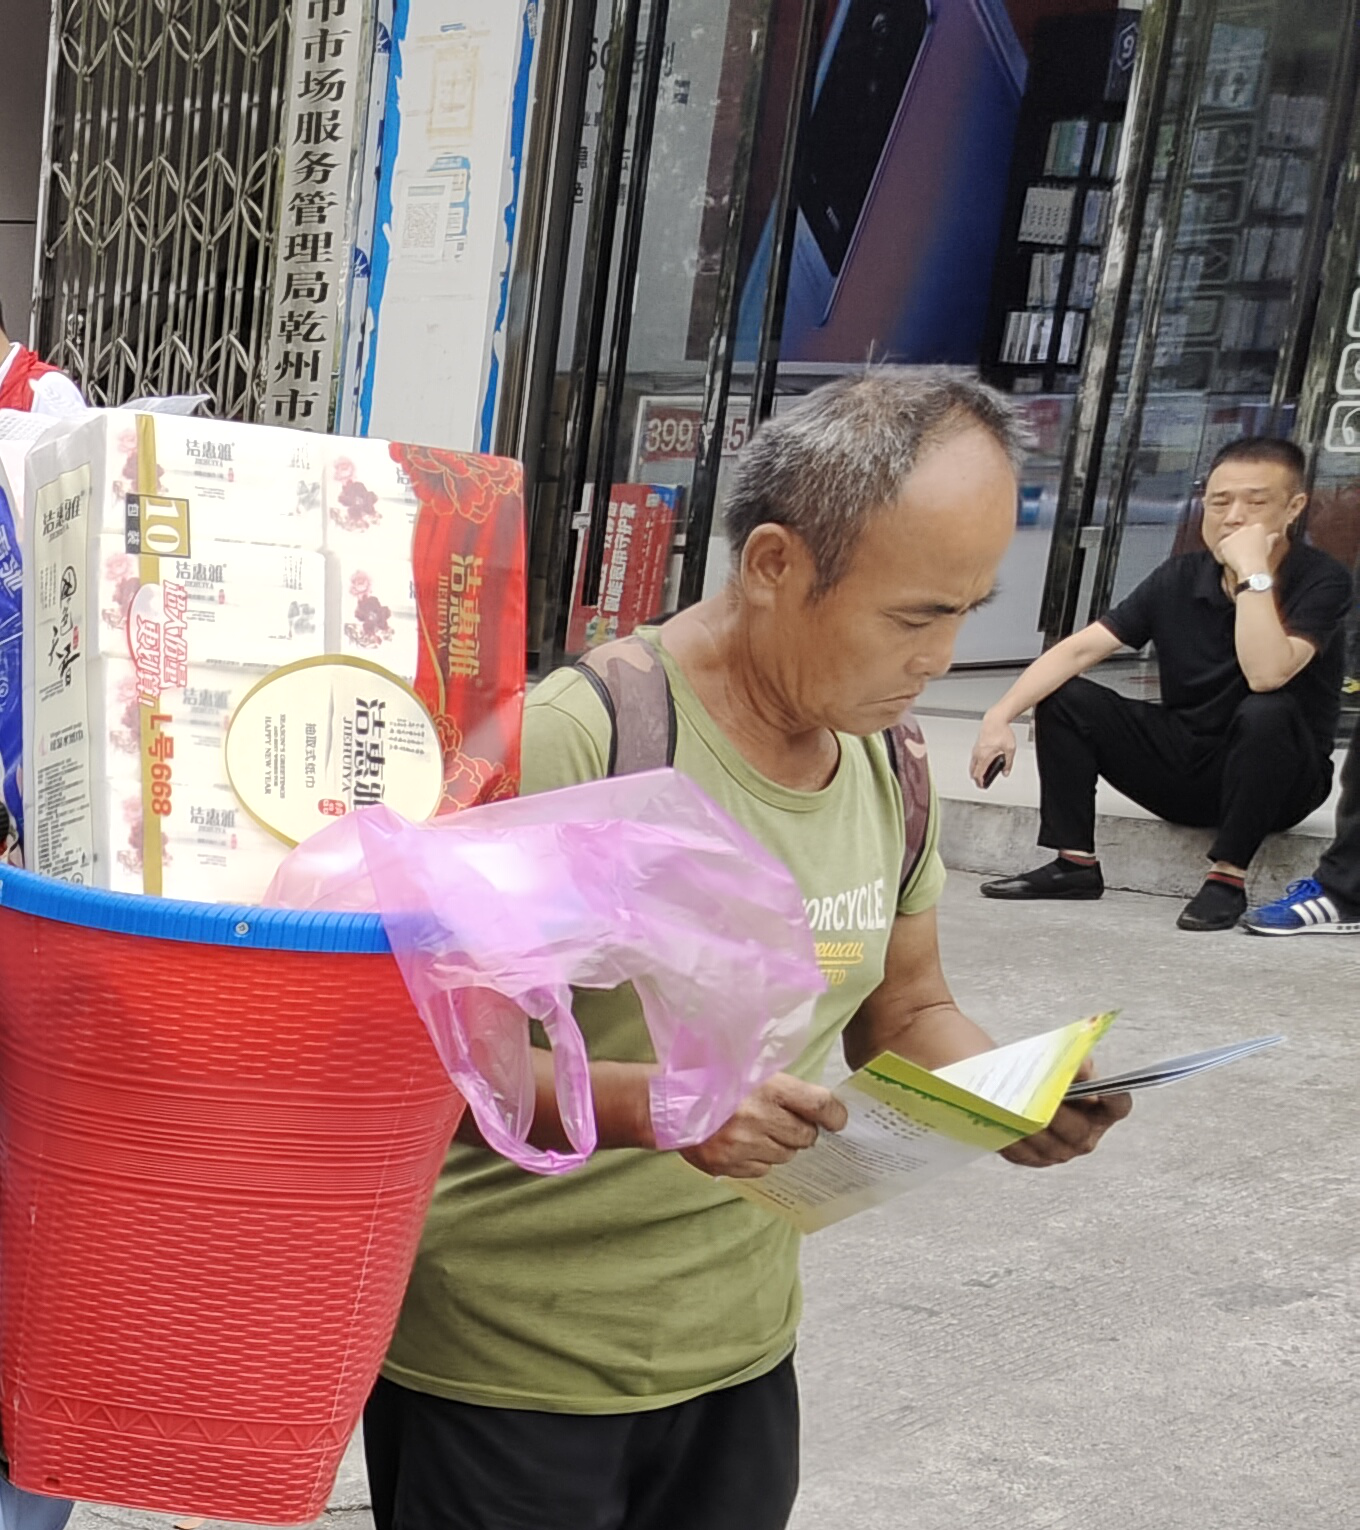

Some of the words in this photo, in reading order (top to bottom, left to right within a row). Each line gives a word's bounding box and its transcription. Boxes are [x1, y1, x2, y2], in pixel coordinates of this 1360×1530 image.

[272, 0, 352, 432] 市市场服务管理局乾州市
[144, 496, 181, 553] 10
[148, 714, 174, 817] L号668
[802, 878, 886, 931] ORCYCLE
